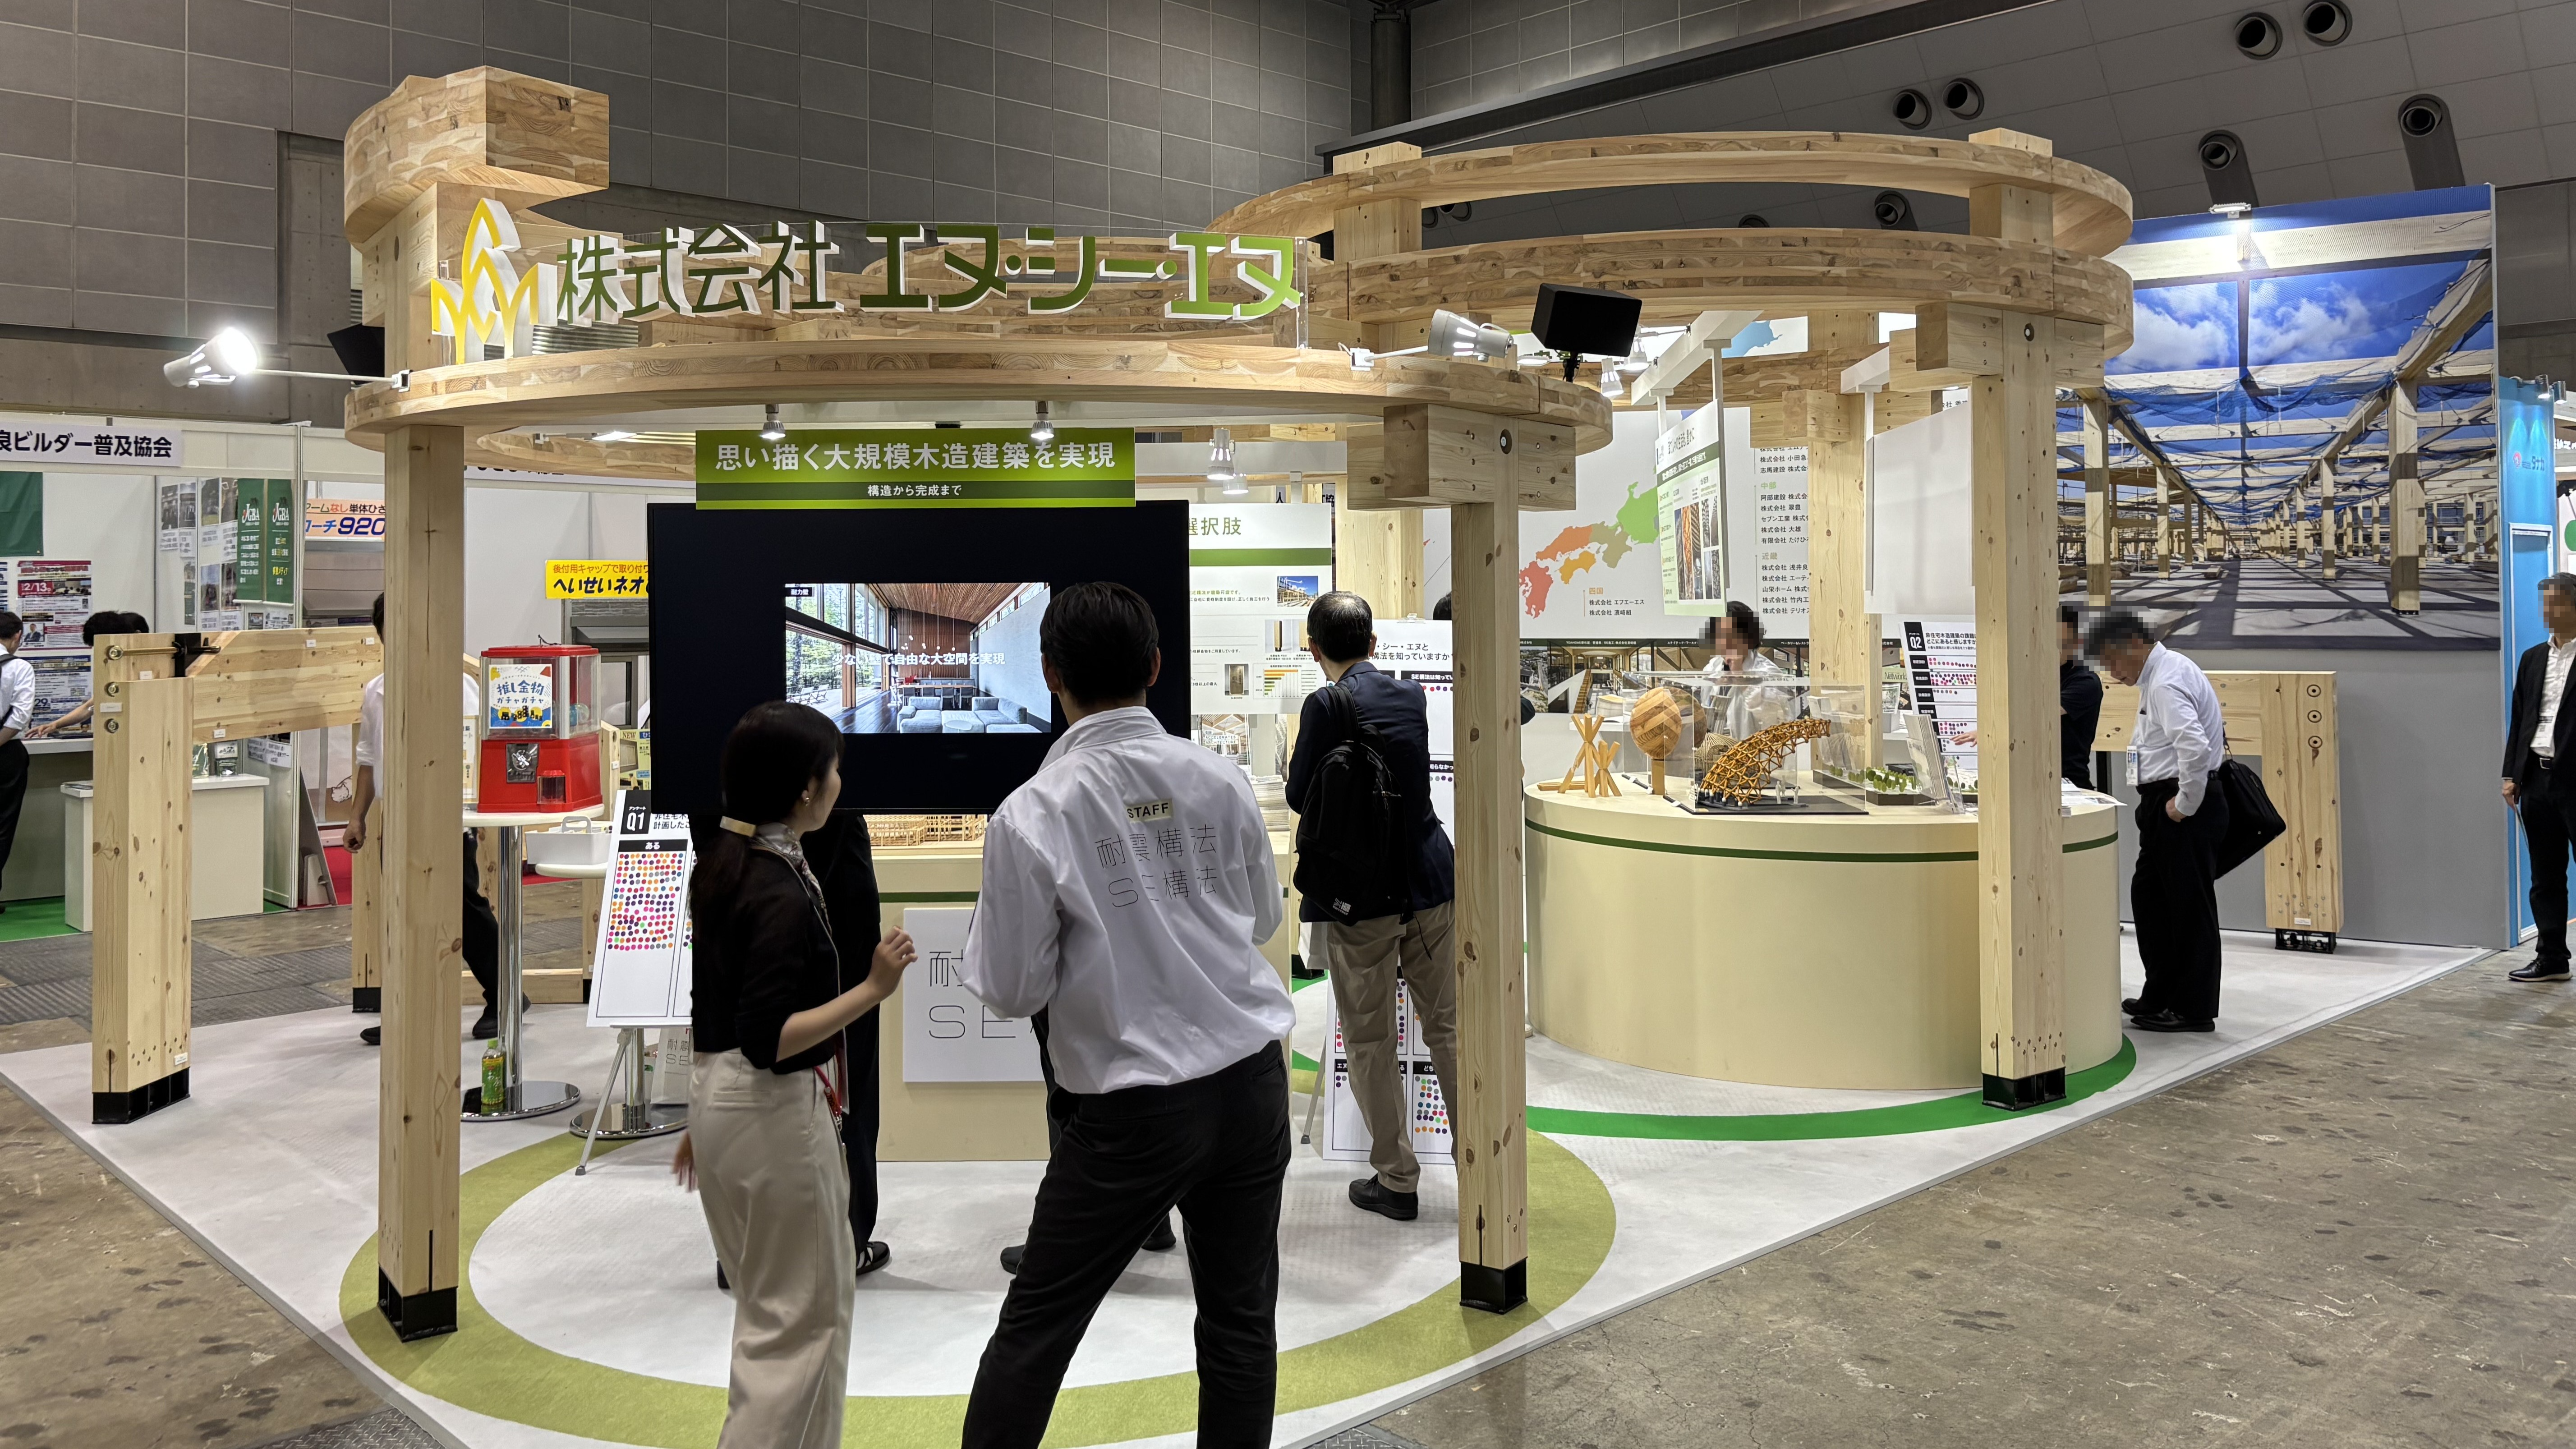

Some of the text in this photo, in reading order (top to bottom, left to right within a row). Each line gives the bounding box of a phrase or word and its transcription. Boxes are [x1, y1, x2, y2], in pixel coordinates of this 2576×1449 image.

[557, 220, 842, 324] 株式会社
[0, 429, 172, 458] 良ビルダー普及協会
[715, 442, 1116, 471] 思い描く大規模木造建築を実現
[867, 484, 962, 497] 構造から完成まで
[1761, 481, 1776, 489] 中部
[553, 575, 649, 594] へいせいネオ
[1910, 636, 1923, 649] Q2
[832, 652, 1006, 666] 少ない壁で自由な大空間を実現
[497, 680, 544, 695] 推し金物
[1127, 802, 1169, 819] STAFF
[626, 812, 645, 831] Q1
[645, 842, 660, 850] ある
[1095, 824, 1216, 869] 耐震構法
[1108, 865, 1217, 907] SE構法
[929, 1005, 1016, 1039] SE
[666, 1053, 688, 1065] SE
